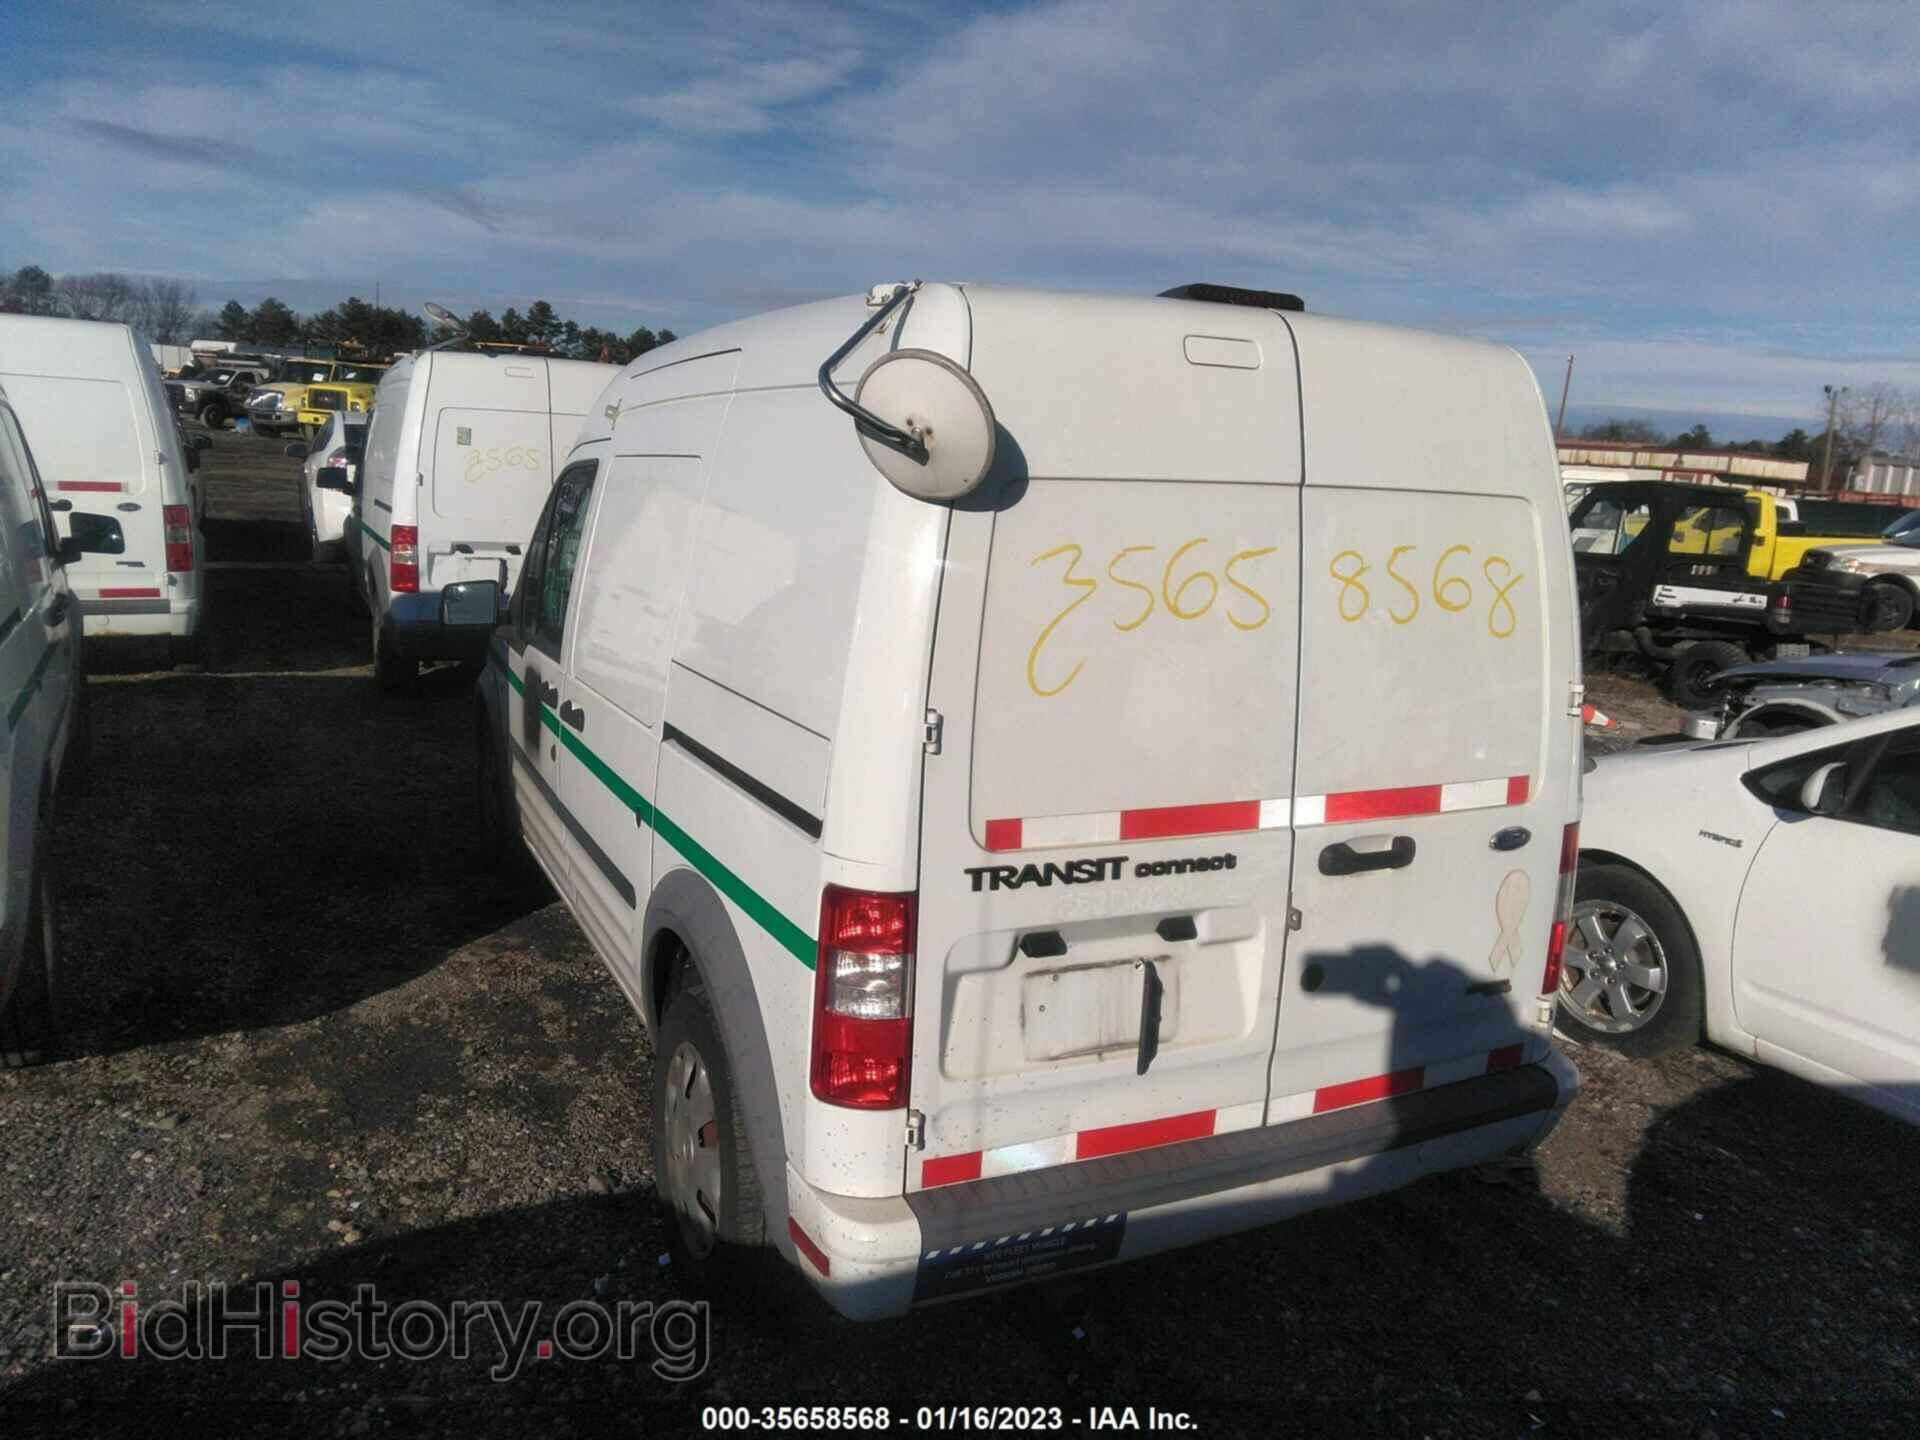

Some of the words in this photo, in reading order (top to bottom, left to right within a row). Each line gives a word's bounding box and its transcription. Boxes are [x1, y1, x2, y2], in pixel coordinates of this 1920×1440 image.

[1027, 537, 1277, 698] 3565
[1329, 543, 1524, 639] 8568
[964, 855, 1129, 892] TRANSIT
[1134, 852, 1237, 878] connect
